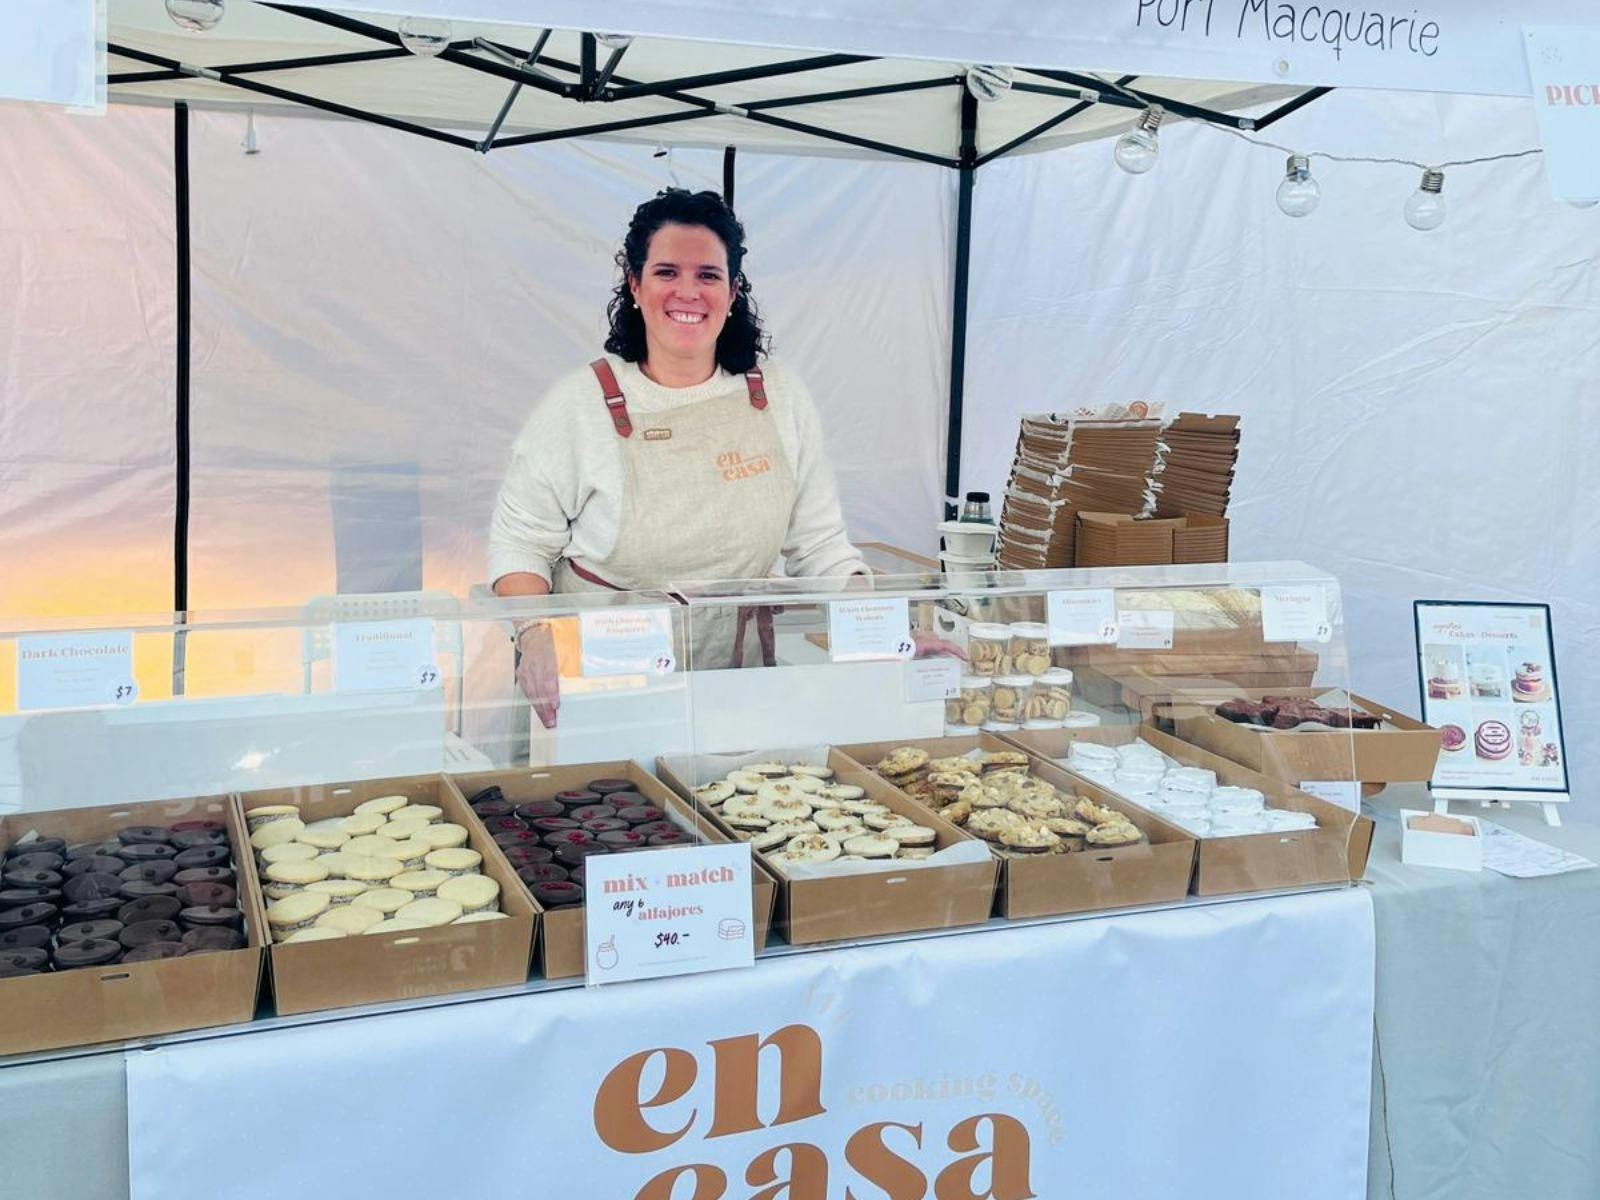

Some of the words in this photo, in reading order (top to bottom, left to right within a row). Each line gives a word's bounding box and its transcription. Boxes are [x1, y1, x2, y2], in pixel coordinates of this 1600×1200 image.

[1237, 0, 1440, 62] Macquarie
[717, 452, 742, 468] en
[22, 648, 58, 660] Dark
[61, 644, 129, 658] Chocolate
[420, 671, 437, 684] $7
[115, 685, 133, 700] $7
[603, 873, 648, 894] mix
[666, 866, 735, 889] match
[612, 899, 635, 918] any
[637, 904, 705, 921] alfajores
[593, 1023, 828, 1154] en
[846, 1070, 999, 1107] cooking
